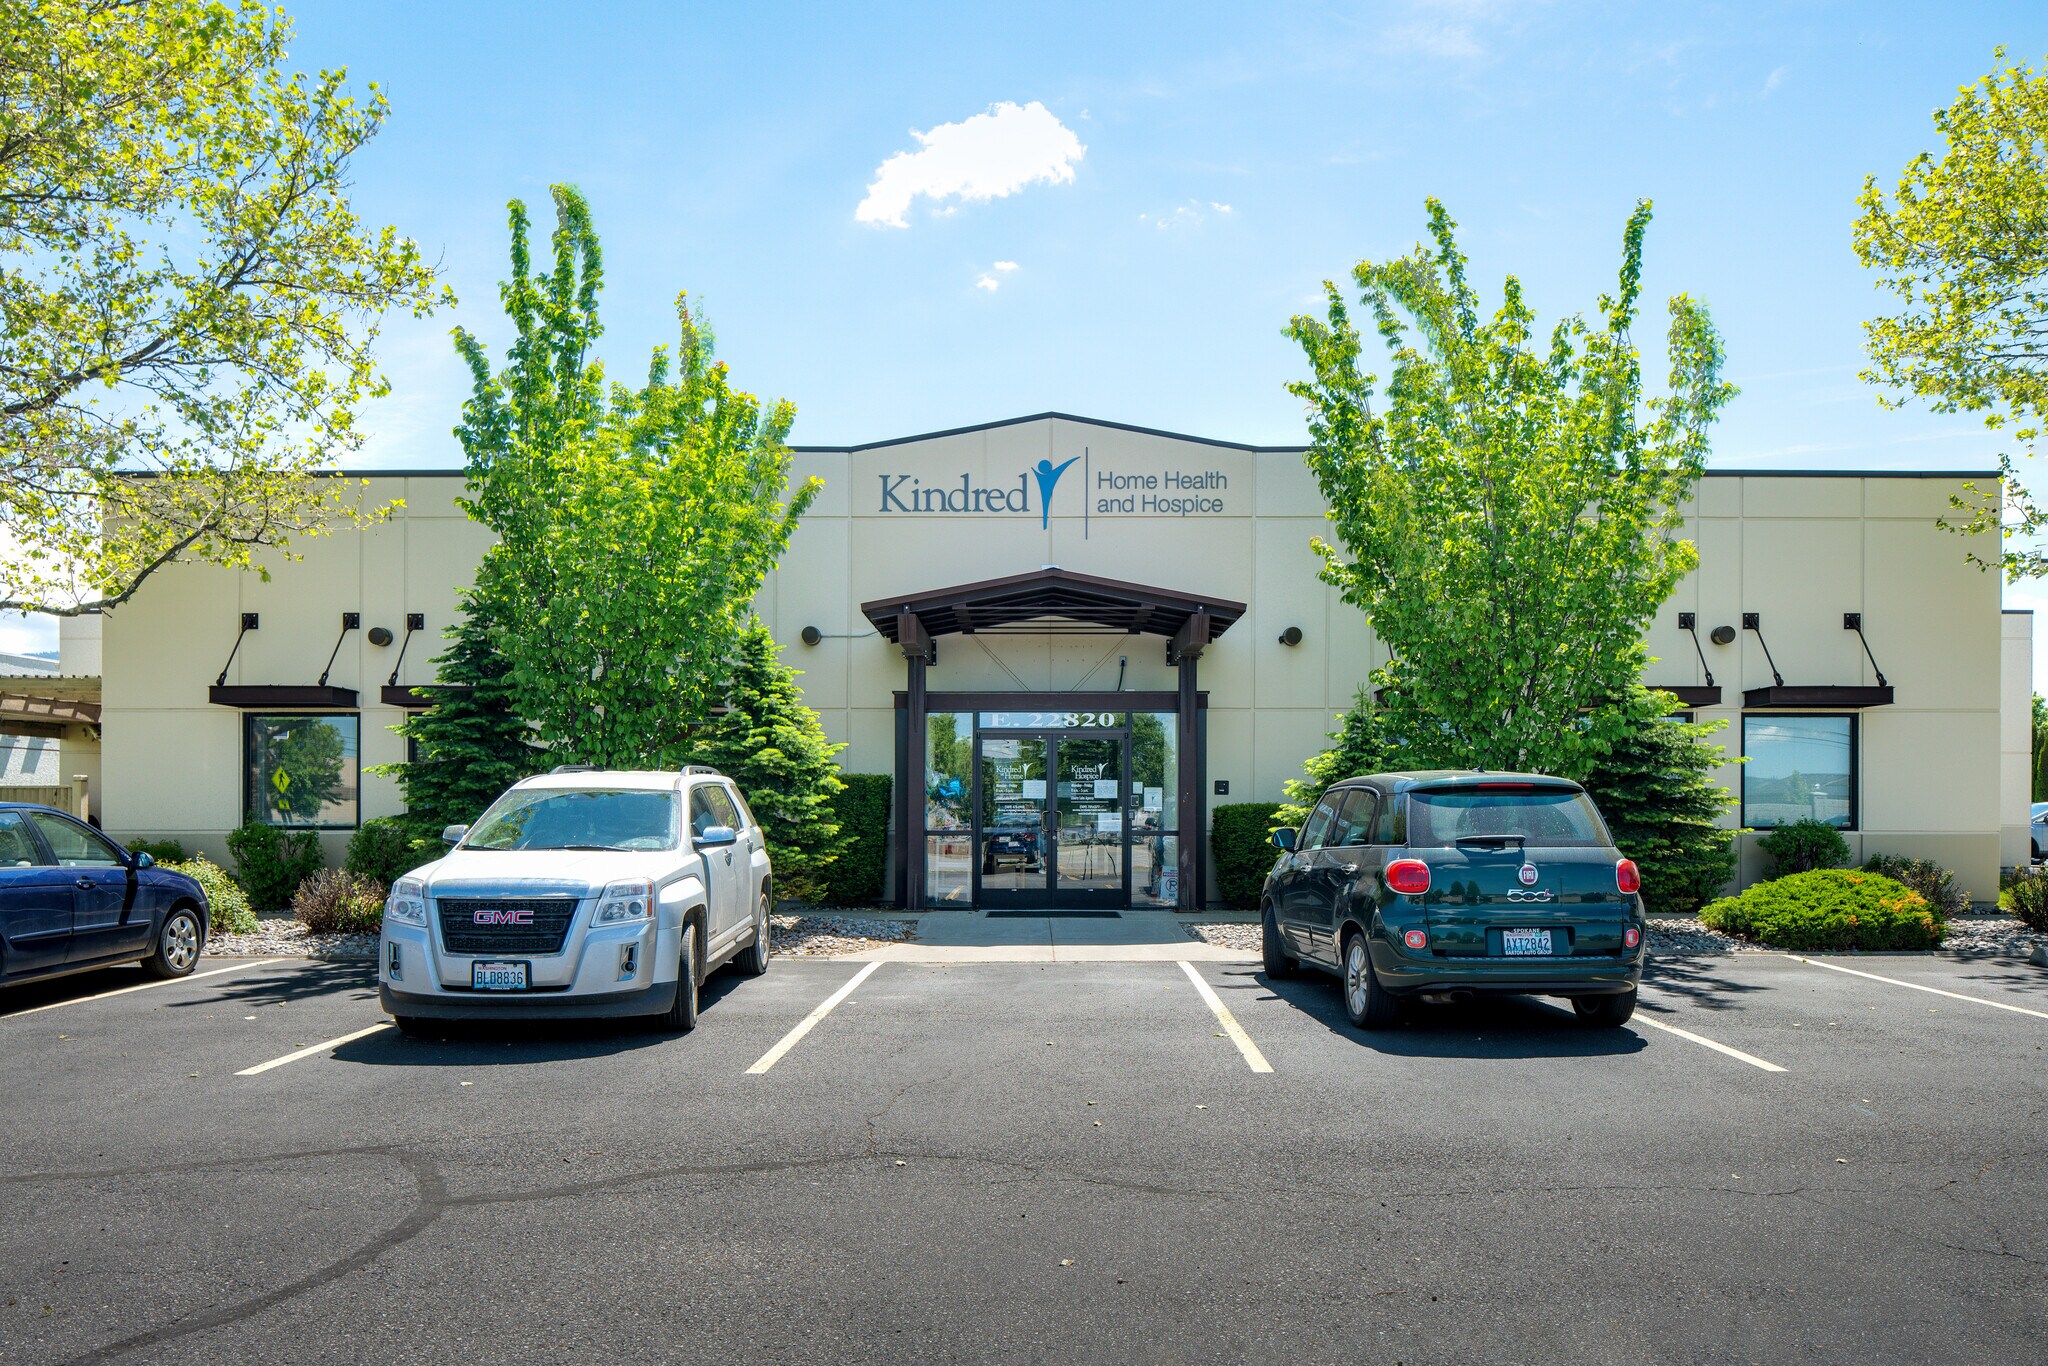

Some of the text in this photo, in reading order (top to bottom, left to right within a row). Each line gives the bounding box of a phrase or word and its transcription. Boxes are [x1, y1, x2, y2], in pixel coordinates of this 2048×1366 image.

[1098, 471, 1227, 490] Home Health
[878, 472, 1031, 513] Kindred
[1097, 494, 1224, 517] and Hospice
[991, 712, 1115, 728] E. 22820
[996, 765, 1022, 773] Kindred
[1071, 764, 1097, 773] Kindred
[1005, 772, 1024, 780] Home
[1075, 772, 1100, 781] Hospice
[1523, 870, 1535, 880] FIAT
[474, 910, 534, 925] GMC
[1506, 937, 1551, 951] AXT2842
[476, 971, 523, 985] BLD8836
